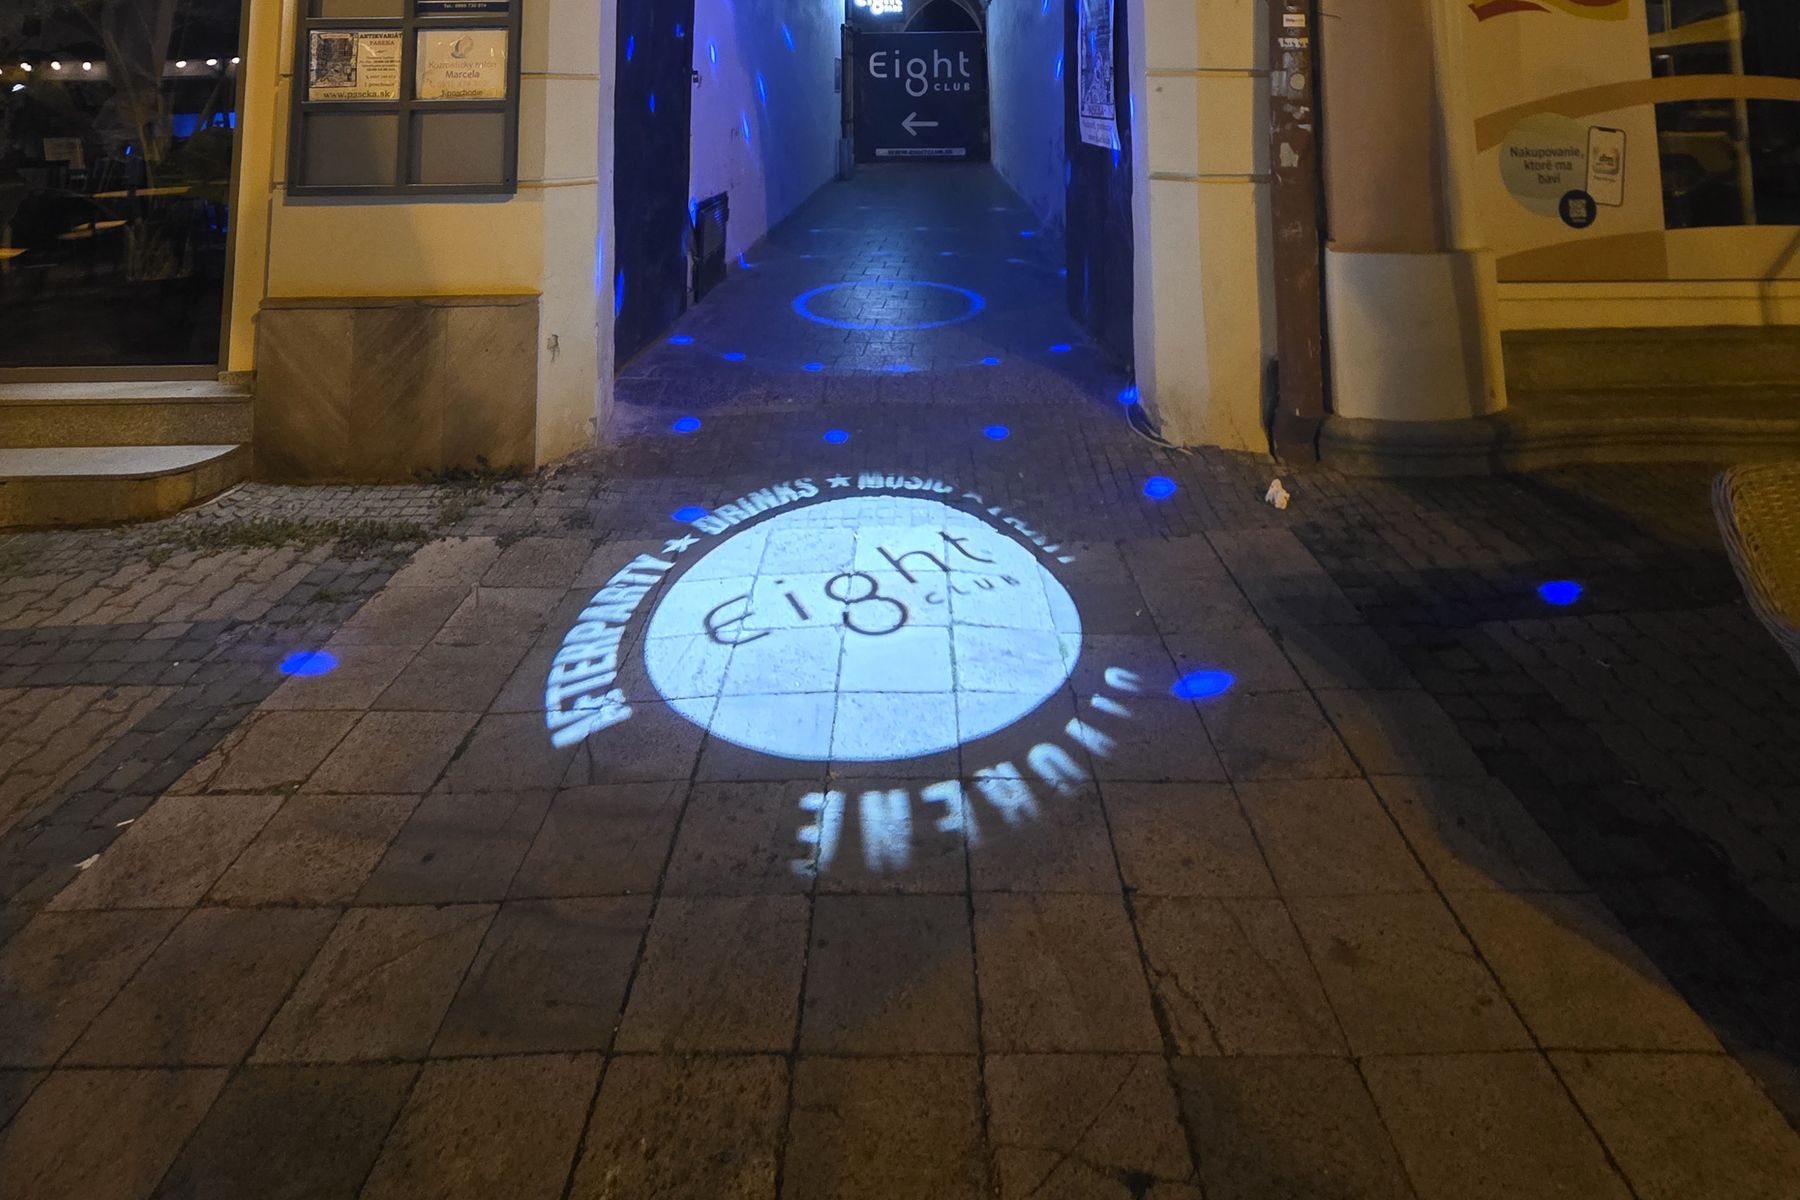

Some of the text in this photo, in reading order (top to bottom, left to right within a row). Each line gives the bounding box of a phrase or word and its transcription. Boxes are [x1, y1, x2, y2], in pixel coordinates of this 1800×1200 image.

[445, 70, 480, 79] Marcela
[869, 49, 970, 97] Eight
[934, 82, 971, 91] CLUB
[323, 90, 391, 99] www.paseka.sk
[691, 477, 820, 536] DRINKS
[702, 530, 996, 646] Eight
